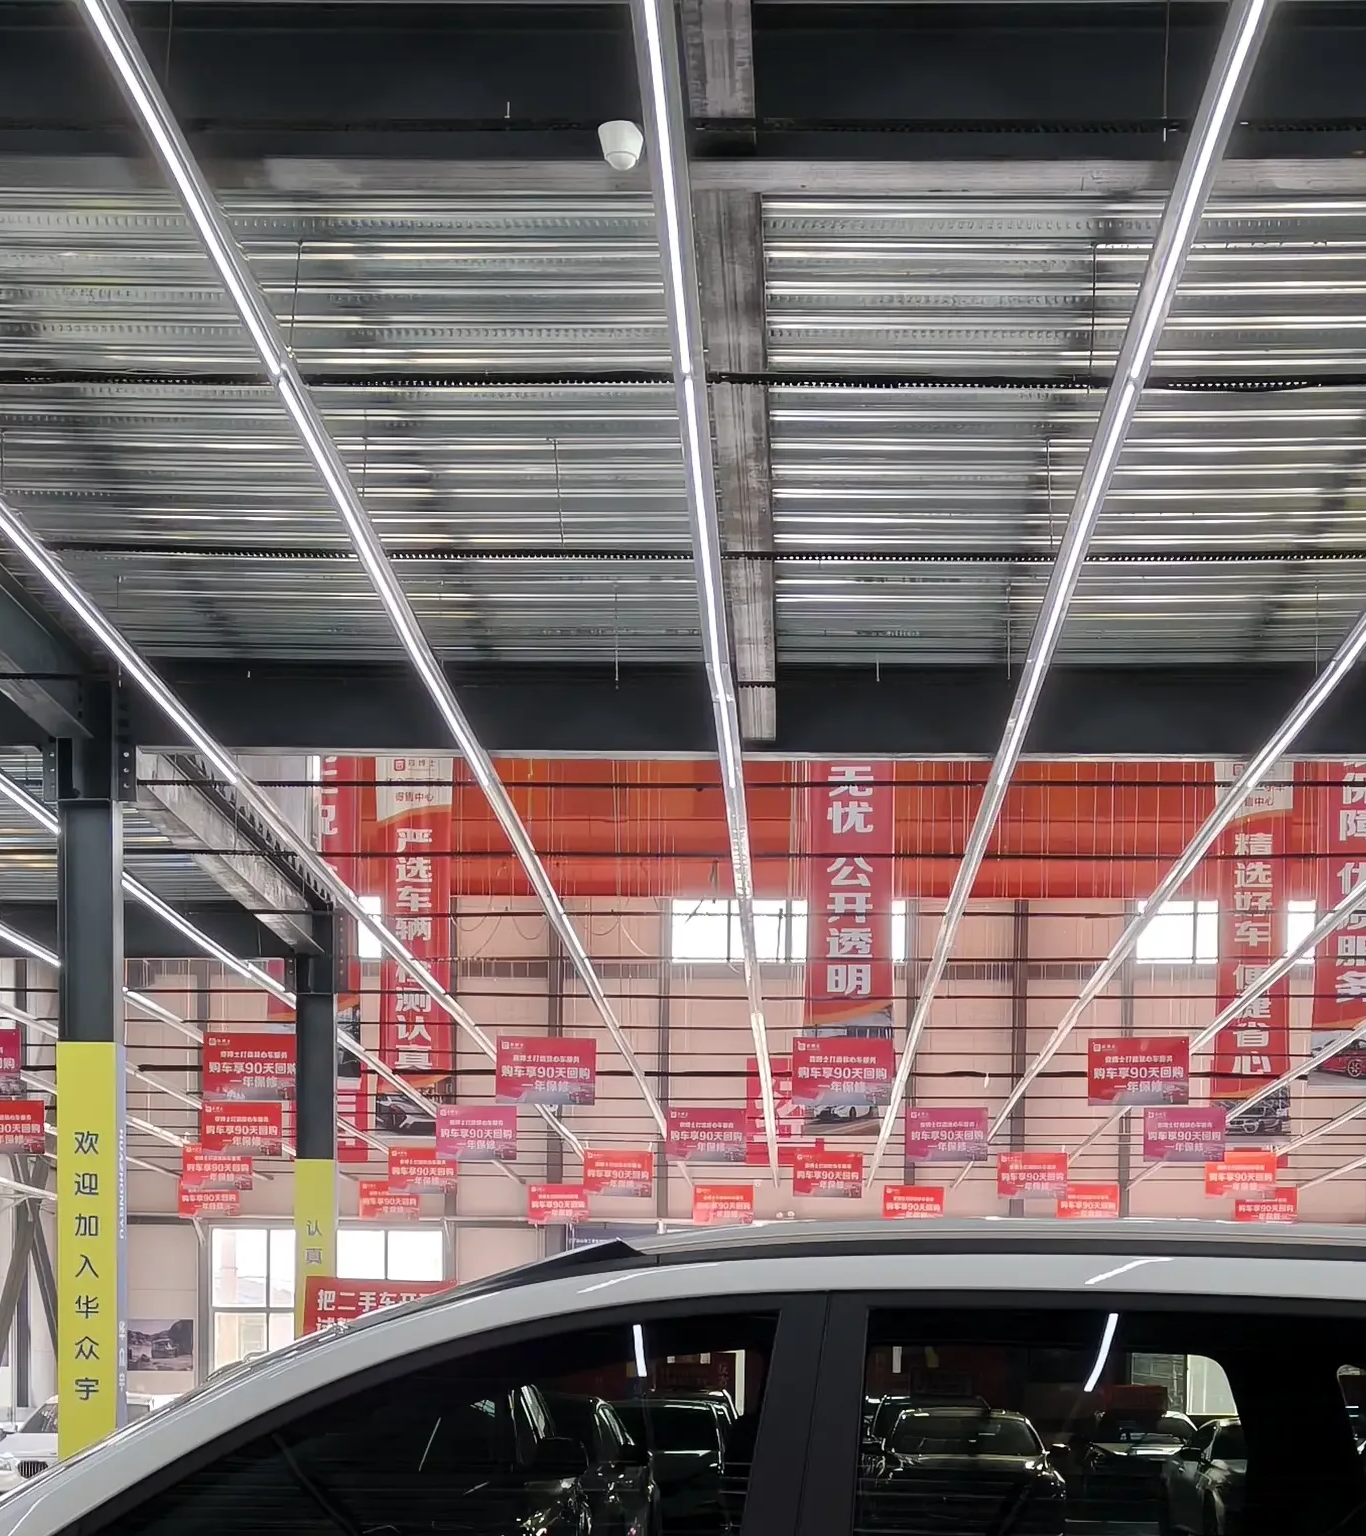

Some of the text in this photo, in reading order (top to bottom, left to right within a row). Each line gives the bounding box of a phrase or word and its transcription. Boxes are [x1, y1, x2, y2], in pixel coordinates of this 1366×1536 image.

[396, 828, 433, 941] 严选车辆
[826, 766, 874, 996] 无忧 公开透明
[1234, 833, 1273, 947] 精选好车
[208, 1061, 296, 1074] 购车享90天回购
[501, 1065, 590, 1079] 购车享90天回购
[797, 1067, 888, 1080] 购车享90天回购
[1093, 1066, 1184, 1080] 购车享90天回购
[229, 1075, 278, 1088] 一年保修
[521, 1080, 569, 1092] 一年保修
[817, 1081, 867, 1093] 一年保修
[1114, 1081, 1163, 1093] 一年保修
[205, 1125, 278, 1136] 购车享90天回购
[439, 1128, 513, 1139] 购车享90天回购
[670, 1131, 742, 1142] 购车享90天回购
[911, 1130, 984, 1141] 购车享90天回购
[1147, 1130, 1221, 1141] 购车享90天回购
[305, 1220, 323, 1264] 认真
[74, 1130, 100, 1400] 欢迎加入华众宇
[317, 1289, 430, 1313] 把二手车开
